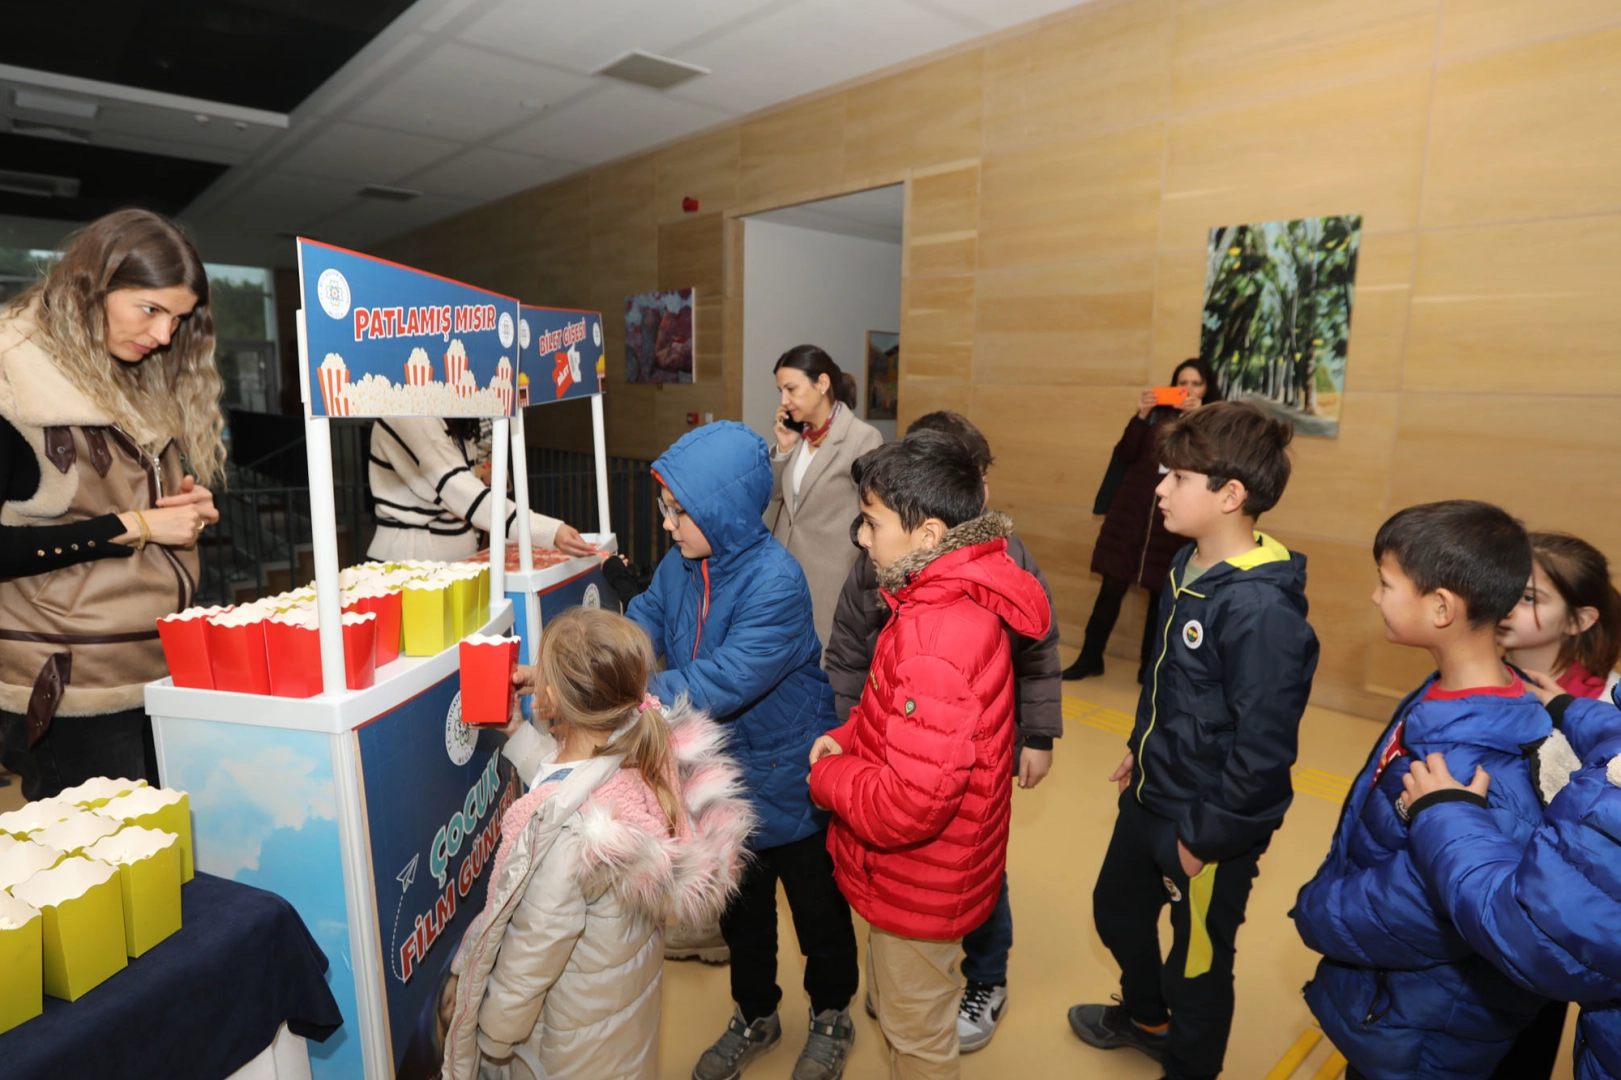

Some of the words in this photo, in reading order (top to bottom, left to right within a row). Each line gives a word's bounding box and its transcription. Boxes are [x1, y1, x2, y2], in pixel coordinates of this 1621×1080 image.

[354, 305, 451, 342] PATLAMIŞ
[455, 304, 496, 333] MISIR
[539, 329, 562, 356] BİLET
[430, 748, 501, 889] ÇOCUK
[400, 878, 456, 983] FİLM
